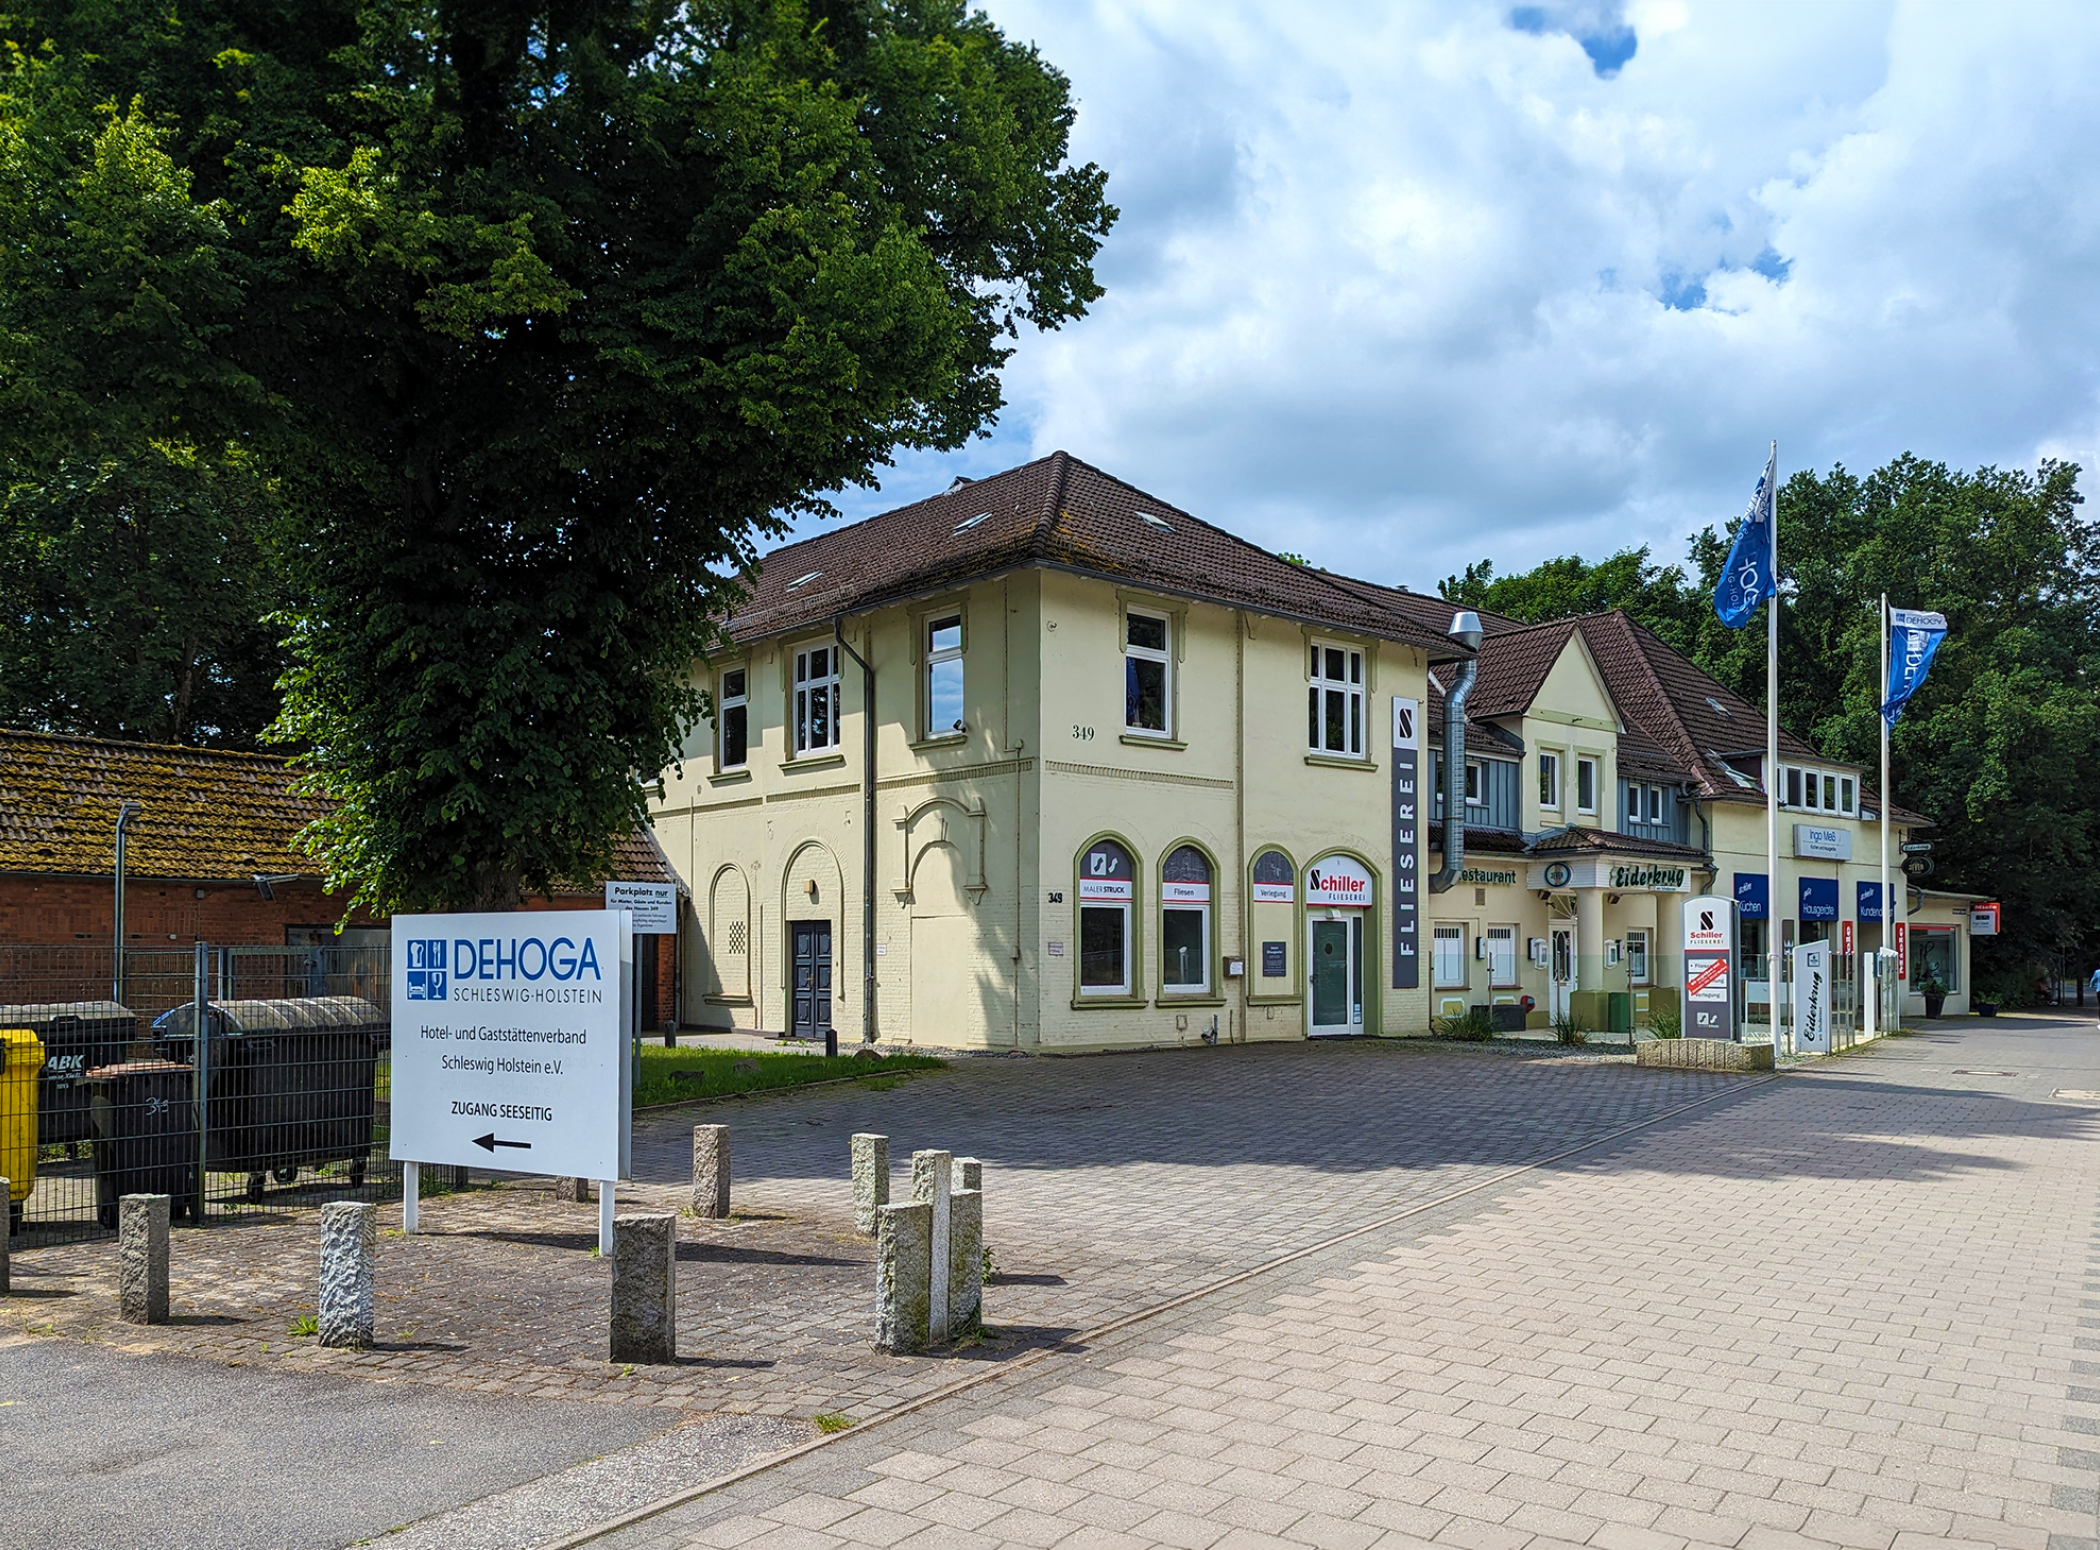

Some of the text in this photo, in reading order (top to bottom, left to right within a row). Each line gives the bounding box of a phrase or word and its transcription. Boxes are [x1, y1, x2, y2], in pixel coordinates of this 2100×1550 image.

[1072, 724, 1095, 741] 349
[1810, 829, 1823, 843] Ingo
[1400, 763, 1414, 956] FLIESEREI
[1310, 869, 1365, 892] Schiller
[1460, 868, 1516, 884] estaurant
[1616, 865, 1684, 888] Eiderkrug
[614, 886, 668, 898] Parkplatz nur
[1048, 892, 1063, 903] 349
[1174, 888, 1195, 896] Fliesen
[1261, 889, 1286, 898] Verlegung
[1328, 893, 1366, 901] FLIESEREI
[1803, 903, 1835, 917] Hausgeräte
[1690, 931, 1723, 939] Schiller
[454, 937, 601, 981] DEHOGA
[453, 987, 602, 1004] SCHLESWIG-HOLSTEIN
[1803, 971, 1823, 1042] Eiderkrug
[420, 1025, 587, 1044] Hotel- und Gaststättenverband
[48, 1055, 85, 1070] ABK
[441, 1055, 564, 1075] Schleswig Holstein e.V.
[145, 1096, 169, 1116] 349
[451, 1101, 553, 1121] ZUGANG SEESEITIG
